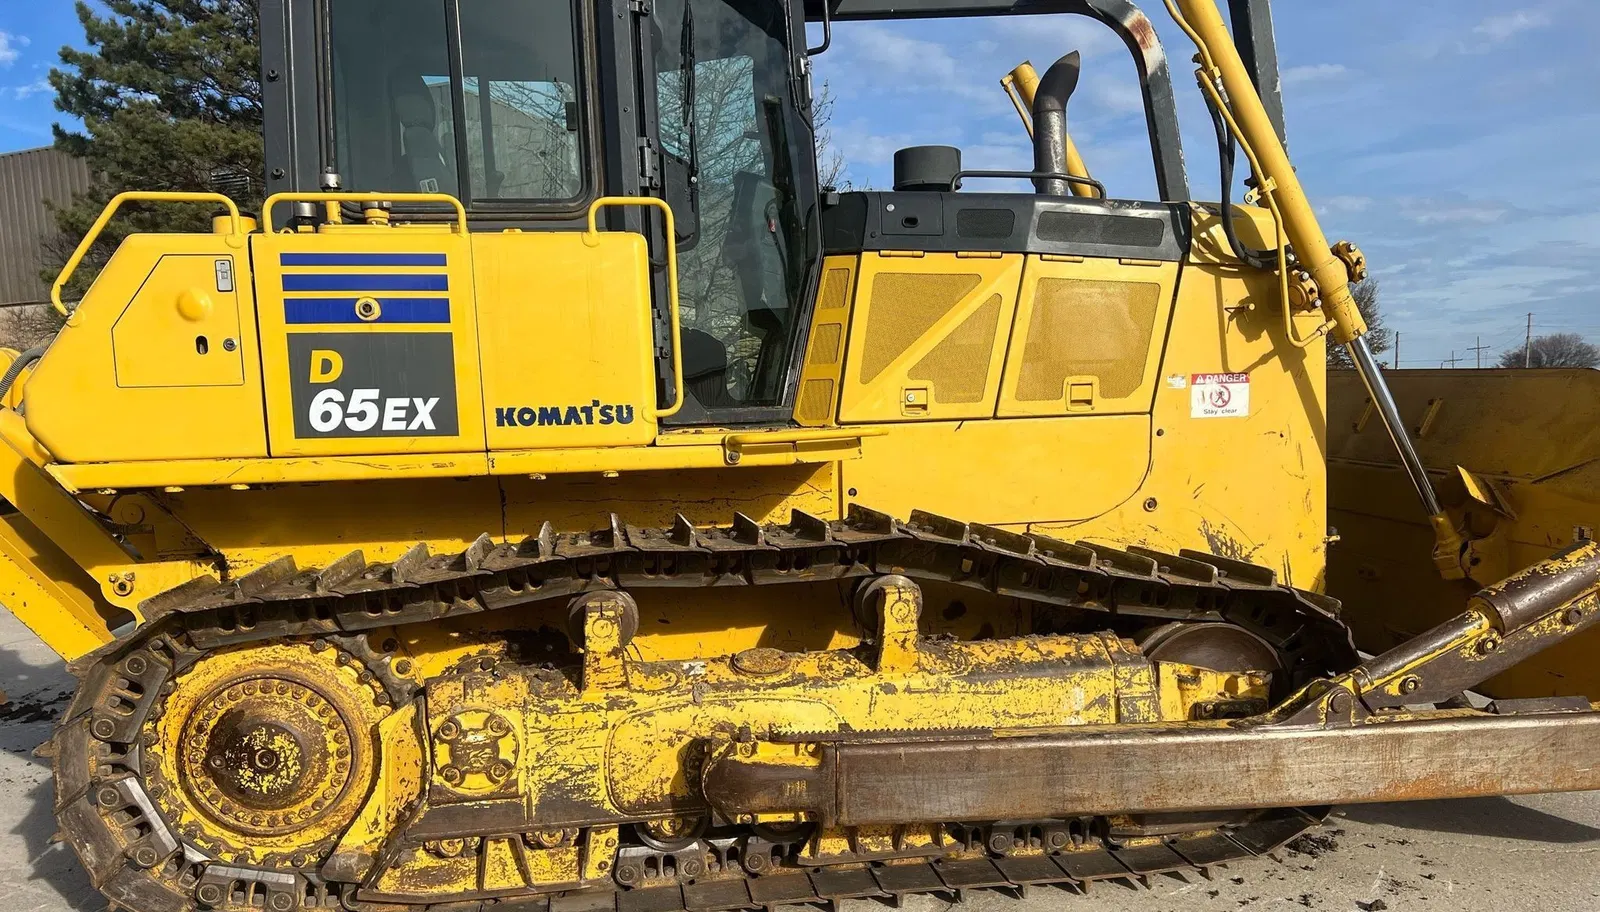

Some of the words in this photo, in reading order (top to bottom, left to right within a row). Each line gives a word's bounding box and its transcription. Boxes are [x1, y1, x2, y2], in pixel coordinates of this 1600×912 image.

[309, 350, 344, 383] D
[1205, 374, 1246, 384] DANGER
[495, 399, 634, 427] KOMATSU
